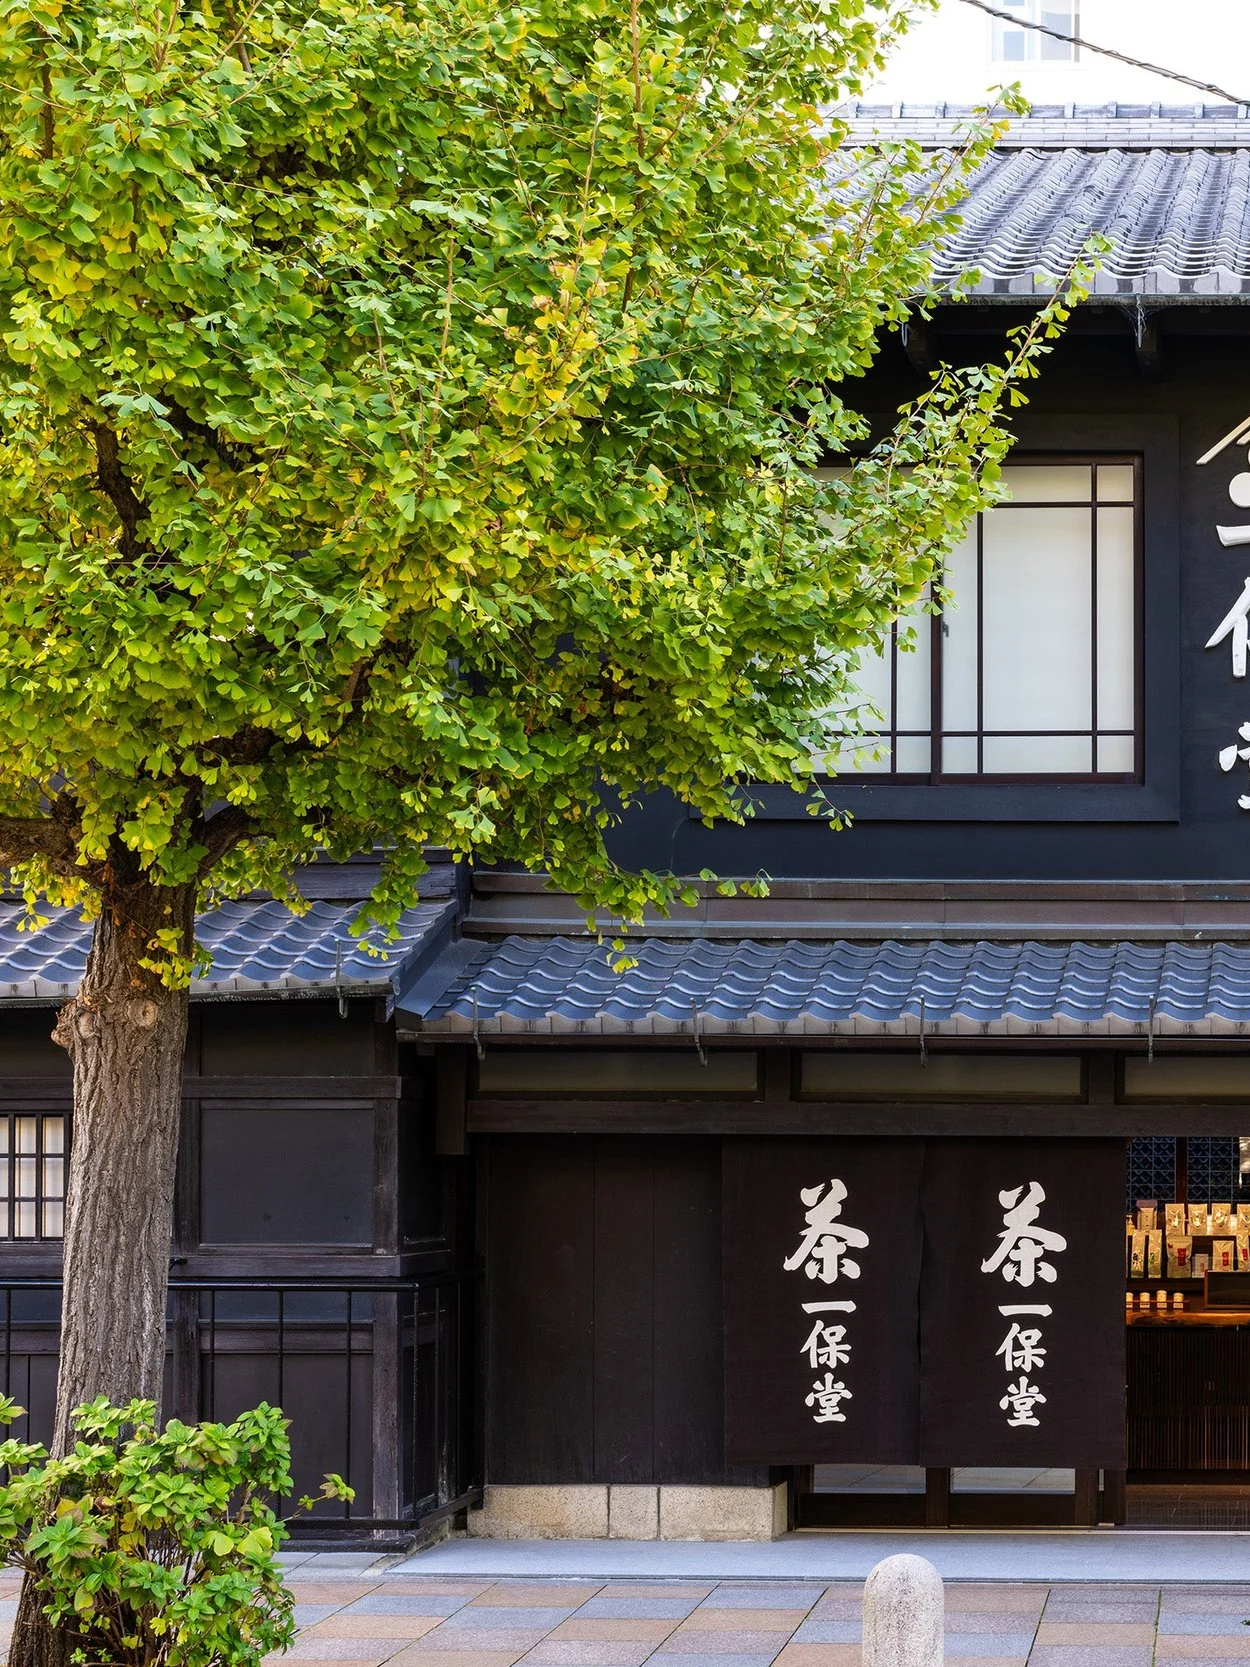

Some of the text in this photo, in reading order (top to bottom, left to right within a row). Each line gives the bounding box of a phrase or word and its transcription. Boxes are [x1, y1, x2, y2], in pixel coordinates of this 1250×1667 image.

[783, 1179, 869, 1423] 茶一保堂
[981, 1182, 1067, 1426] 茶一保堂
